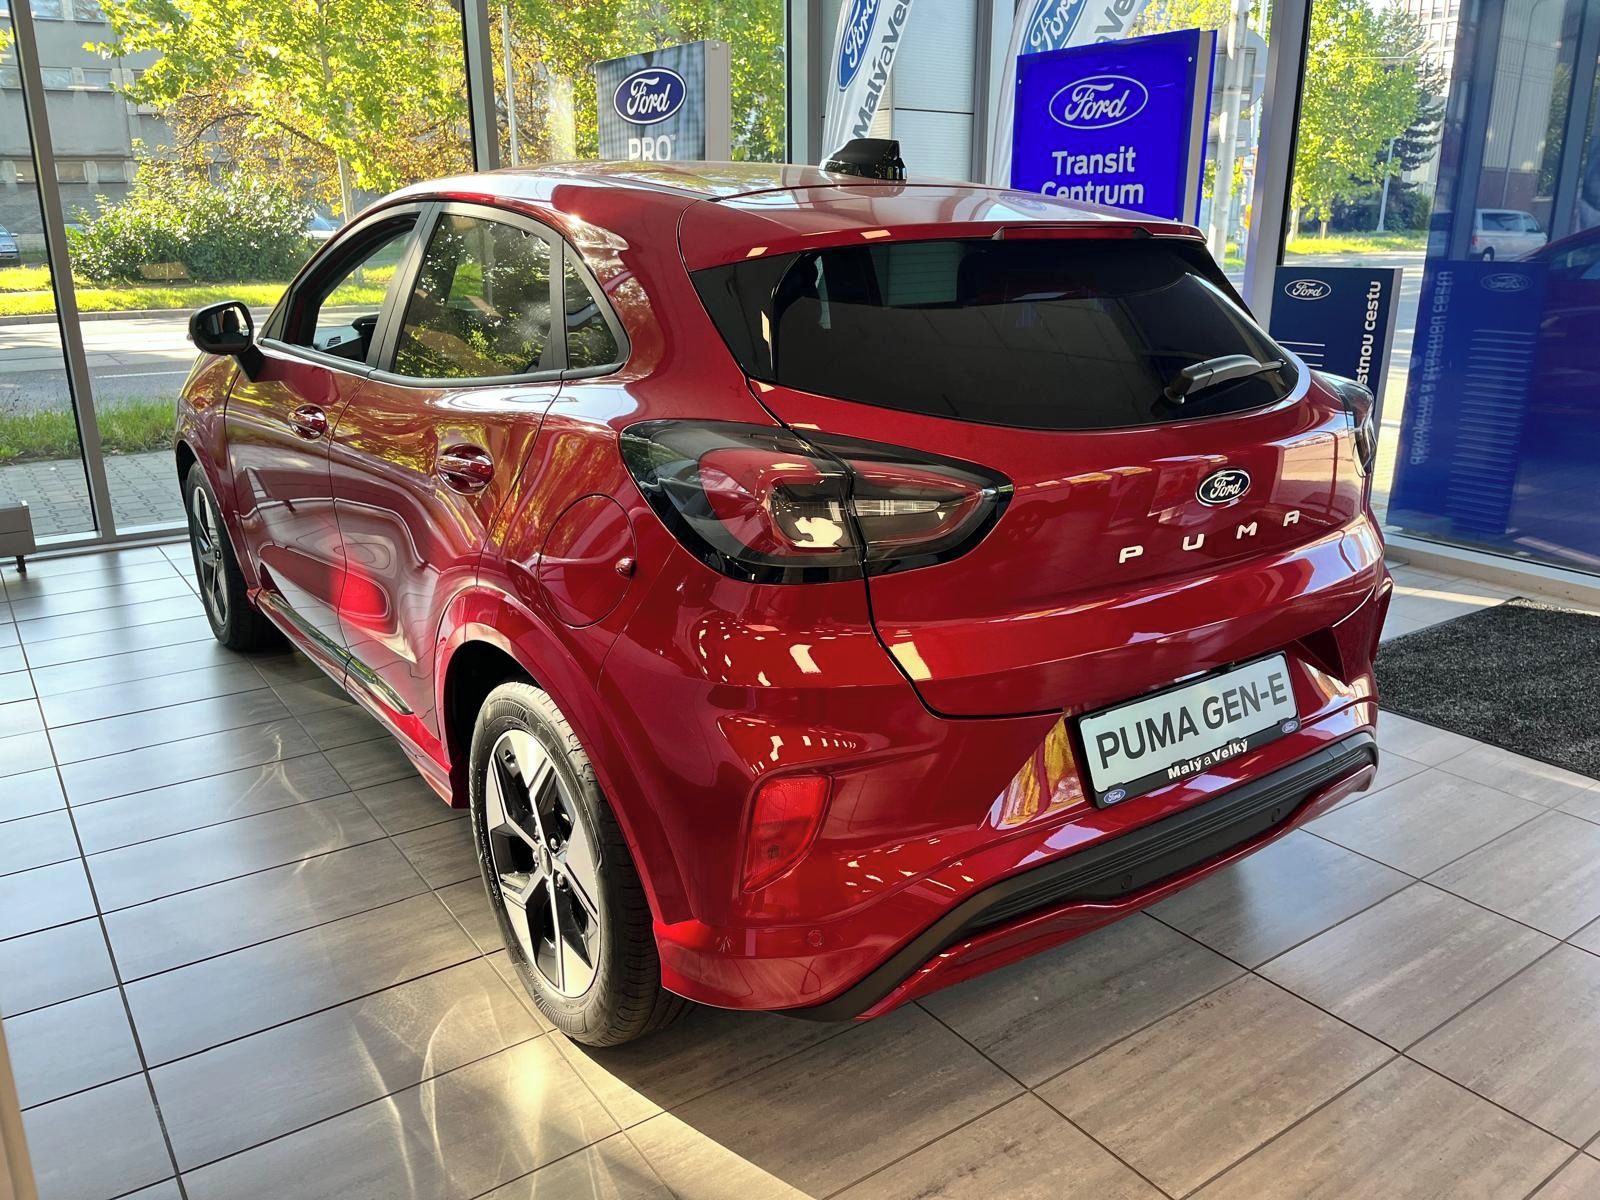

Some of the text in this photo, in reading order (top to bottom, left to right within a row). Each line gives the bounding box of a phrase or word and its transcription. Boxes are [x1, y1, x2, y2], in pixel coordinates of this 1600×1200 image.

[1030, 0, 1080, 52] For
[852, 0, 912, 138] Malý a Ve
[626, 77, 671, 115] Ford
[1064, 83, 1130, 121] Ford
[1052, 146, 1136, 176] Transit
[1292, 281, 1323, 296] Ford
[1364, 281, 1381, 331] cestu
[1119, 510, 1300, 563] PUMA
[1095, 672, 1287, 770] PUMA GEN-E
[1167, 739, 1248, 779] Malý a Velký
